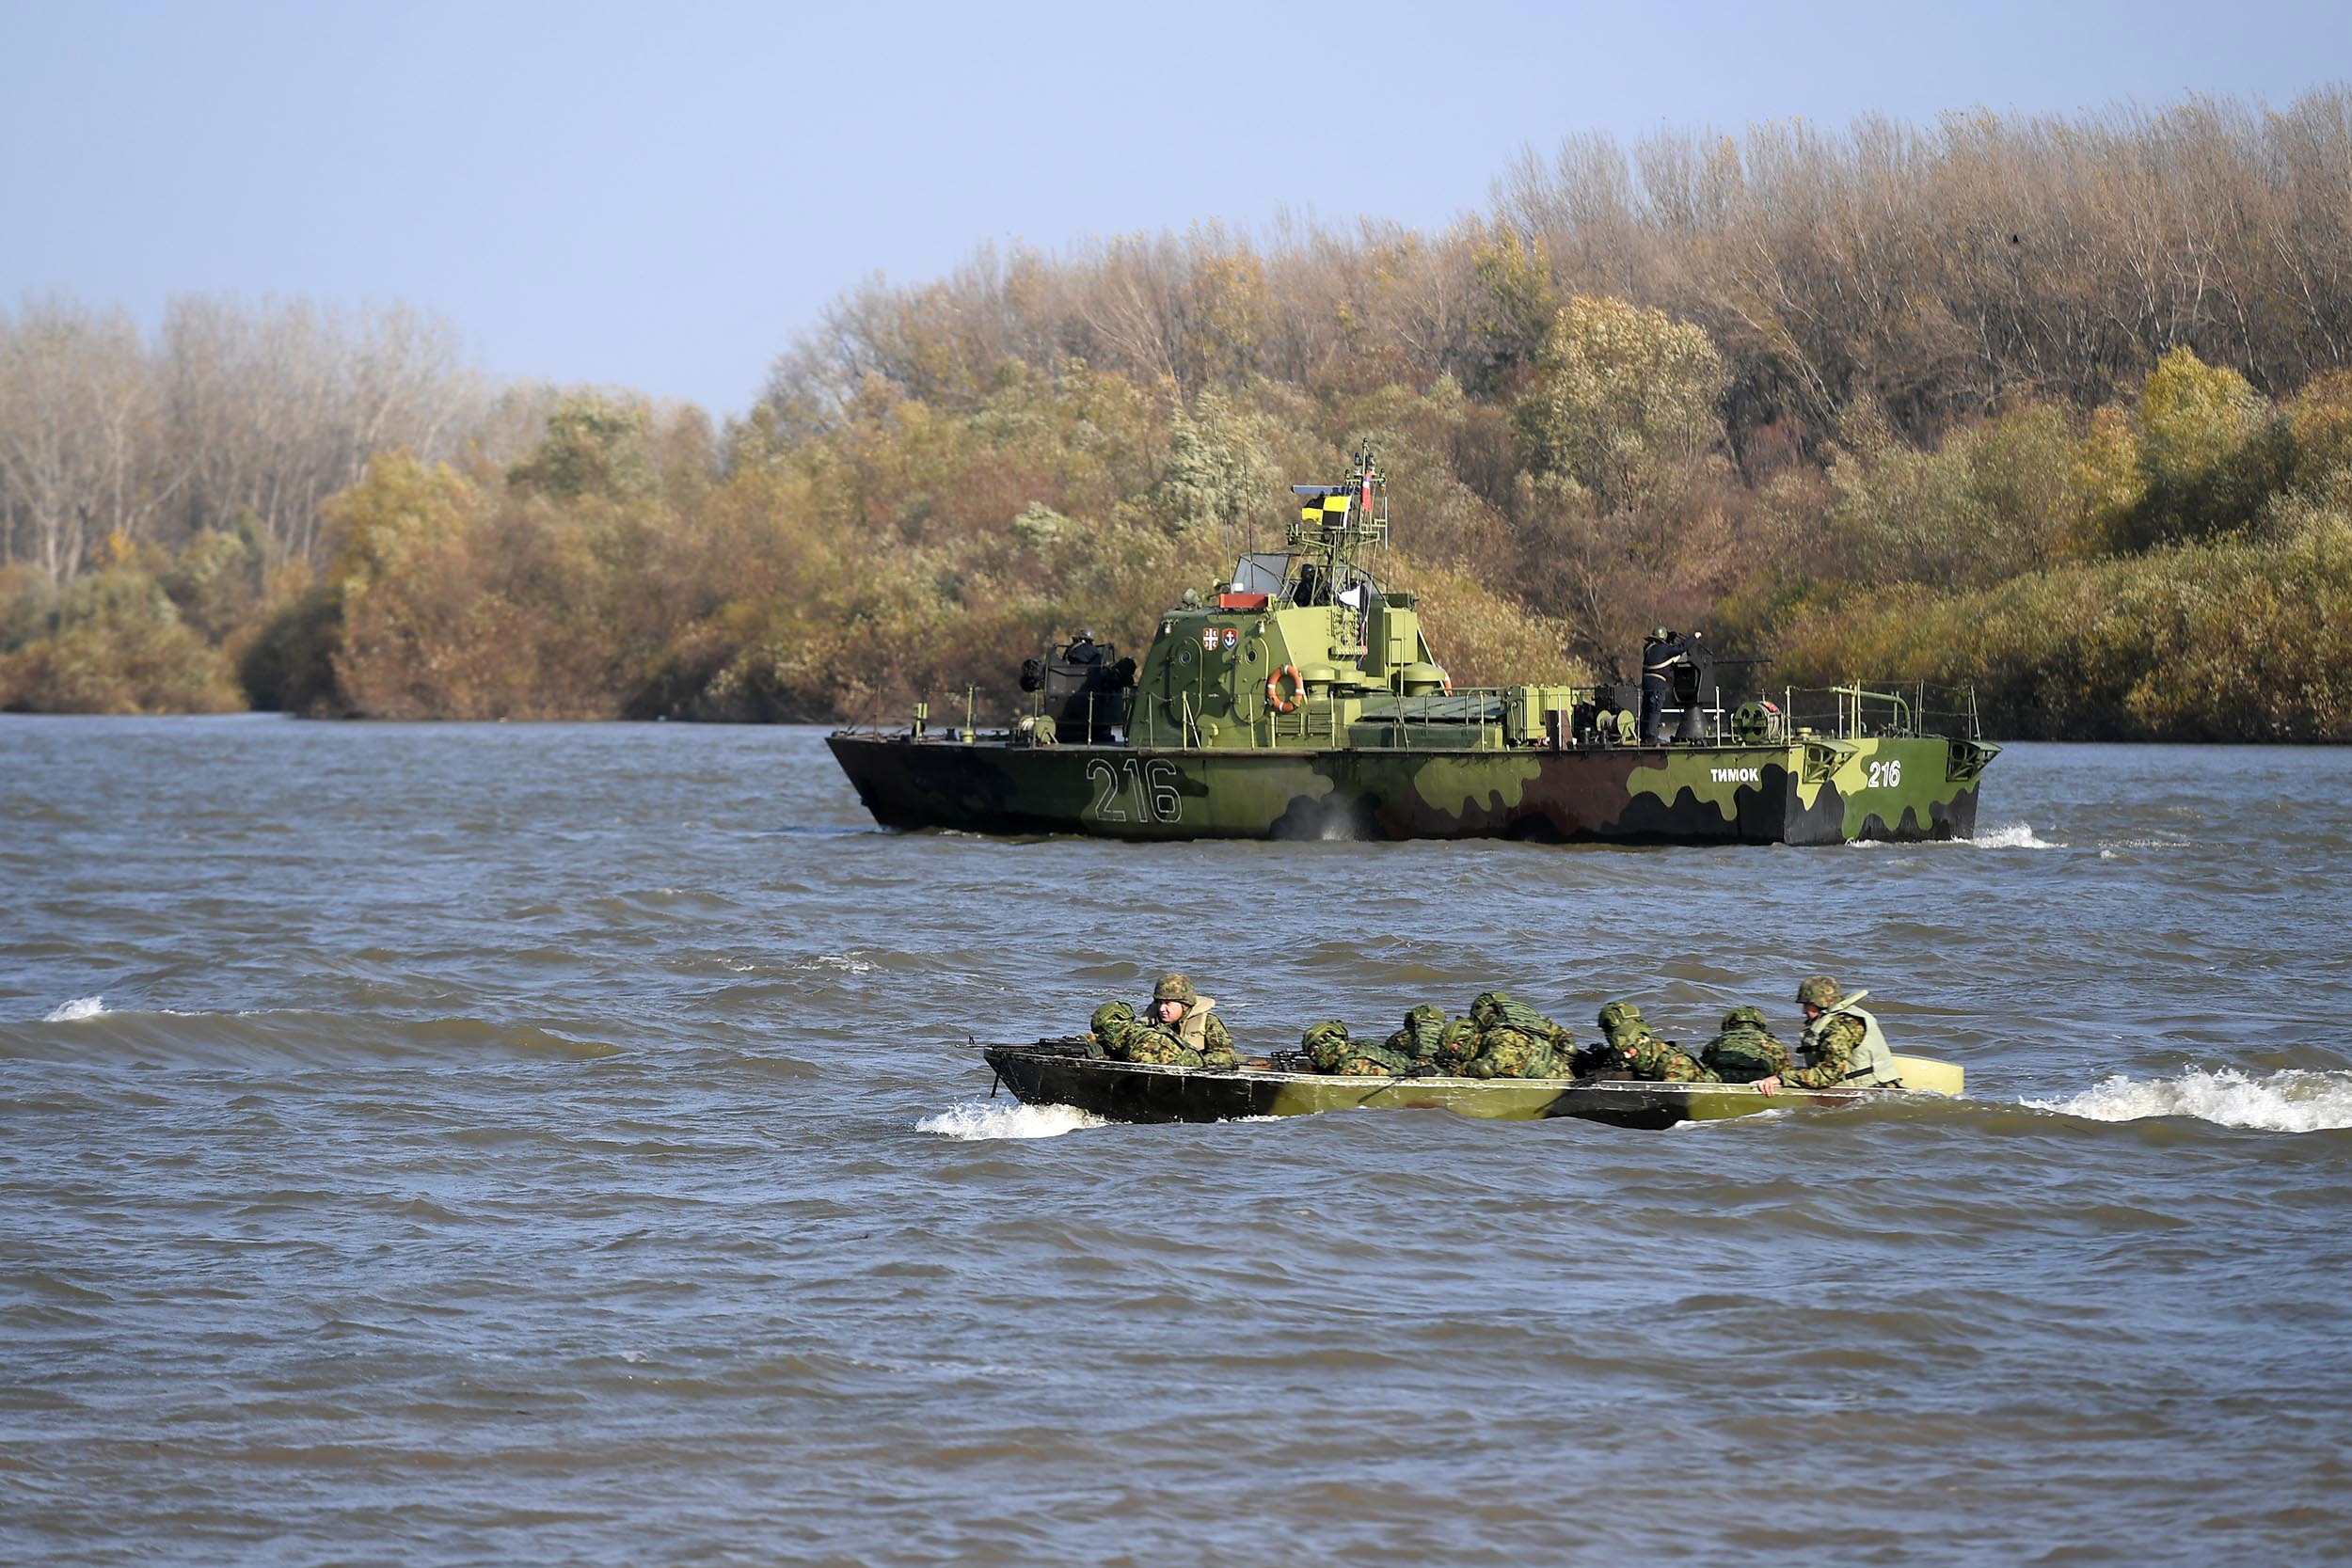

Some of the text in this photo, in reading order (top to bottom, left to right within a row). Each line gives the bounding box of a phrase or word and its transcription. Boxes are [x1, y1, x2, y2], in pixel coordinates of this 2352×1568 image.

[1710, 768, 1759, 783] ТИМОК
[1867, 760, 1901, 788] 216
[1087, 758, 1183, 823] 216
